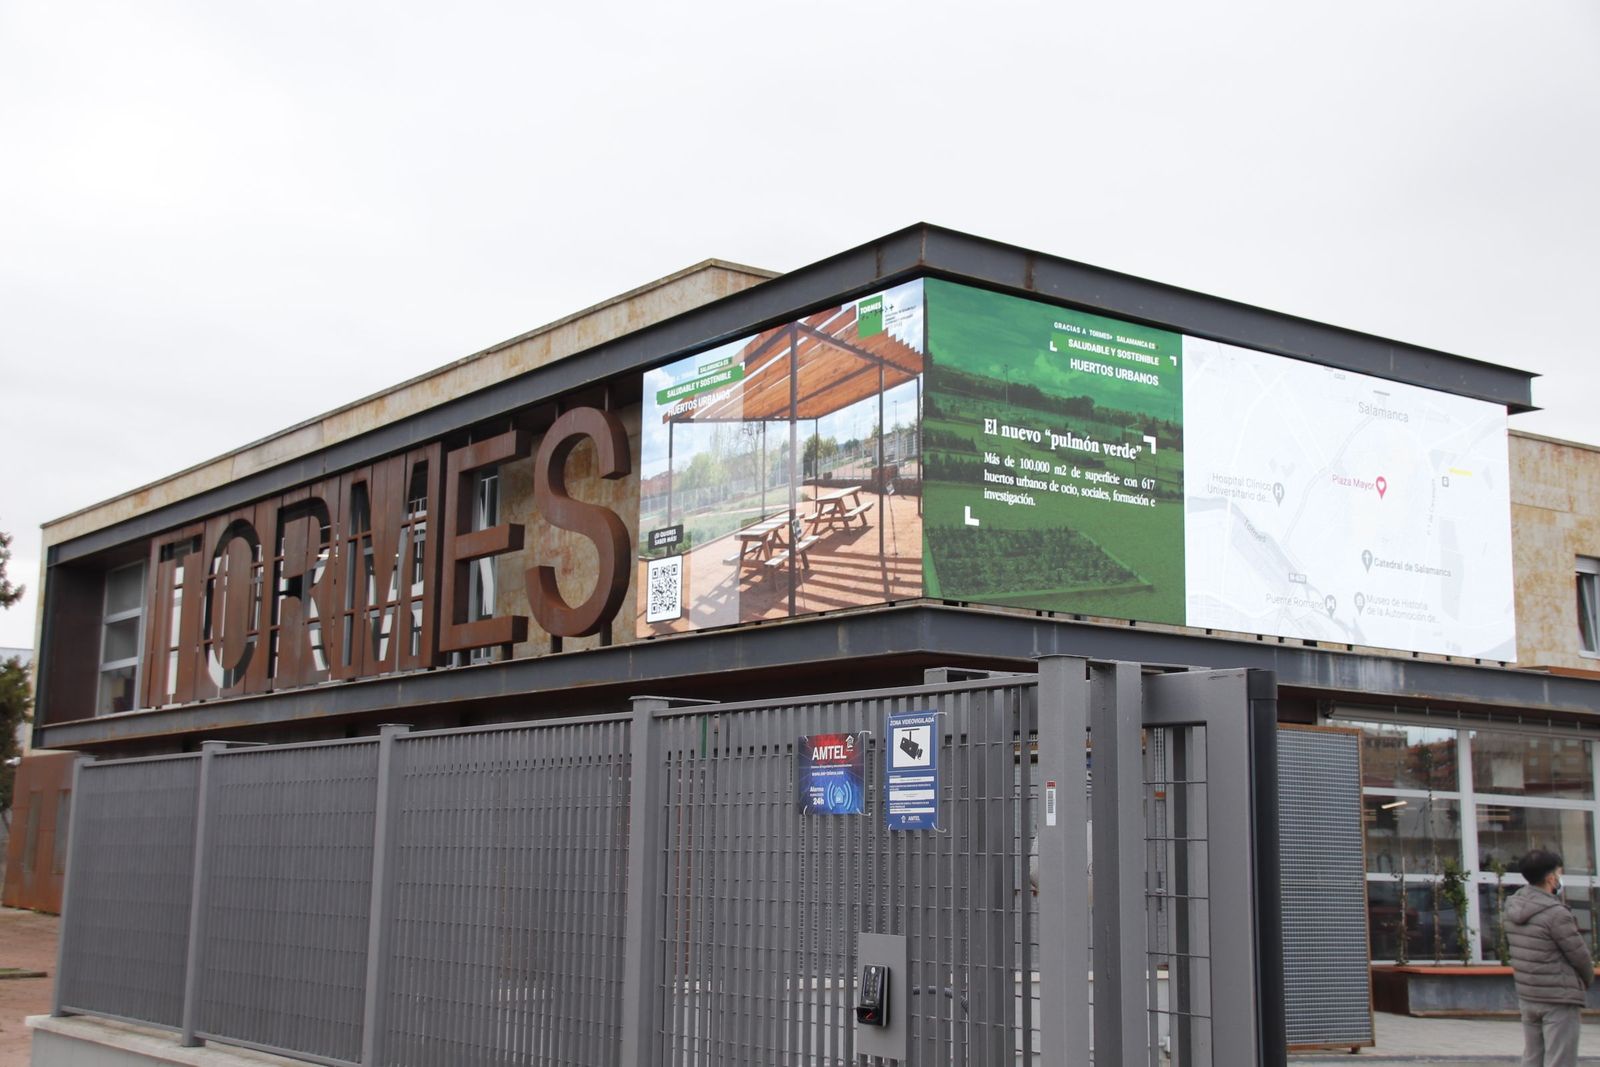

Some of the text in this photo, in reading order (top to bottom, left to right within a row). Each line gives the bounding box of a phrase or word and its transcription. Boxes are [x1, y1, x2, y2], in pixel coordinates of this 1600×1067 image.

[1053, 321, 1081, 334] GRACIAS
[1116, 335, 1148, 348] SALAMANCA
[1068, 338, 1160, 366] SALUDABLE Y SOSTENIBLE
[1070, 358, 1160, 386] HUERTOS URBANOS
[667, 371, 731, 398] SALUDABLE Y SOSTENIBLE
[668, 400, 697, 416] HUERTOS
[1357, 401, 1409, 423] Salamanca
[984, 418, 998, 436] El
[1001, 424, 1041, 443] nuevo
[984, 452, 1156, 491] Más de 100.000 m2 de superficie con 617
[1211, 472, 1245, 487] Hospital
[984, 469, 1156, 508] huertos urbanos de ocio, sociales, formación e
[1332, 473, 1375, 491] Plaza Mayor
[984, 488, 1036, 506] investigación.
[1207, 483, 1255, 501] Universitario
[141, 406, 631, 710] TORMES
[1374, 557, 1452, 577] Catedral de Salamanca
[1265, 592, 1324, 610] Puente Romano
[1366, 594, 1428, 611] Museo de Historia
[1366, 606, 1376, 616] de
[1377, 607, 1384, 617] la
[902, 716, 935, 726] VIDEOVIGILADA
[812, 744, 847, 761] AMTEL
[813, 797, 825, 805] 24h
